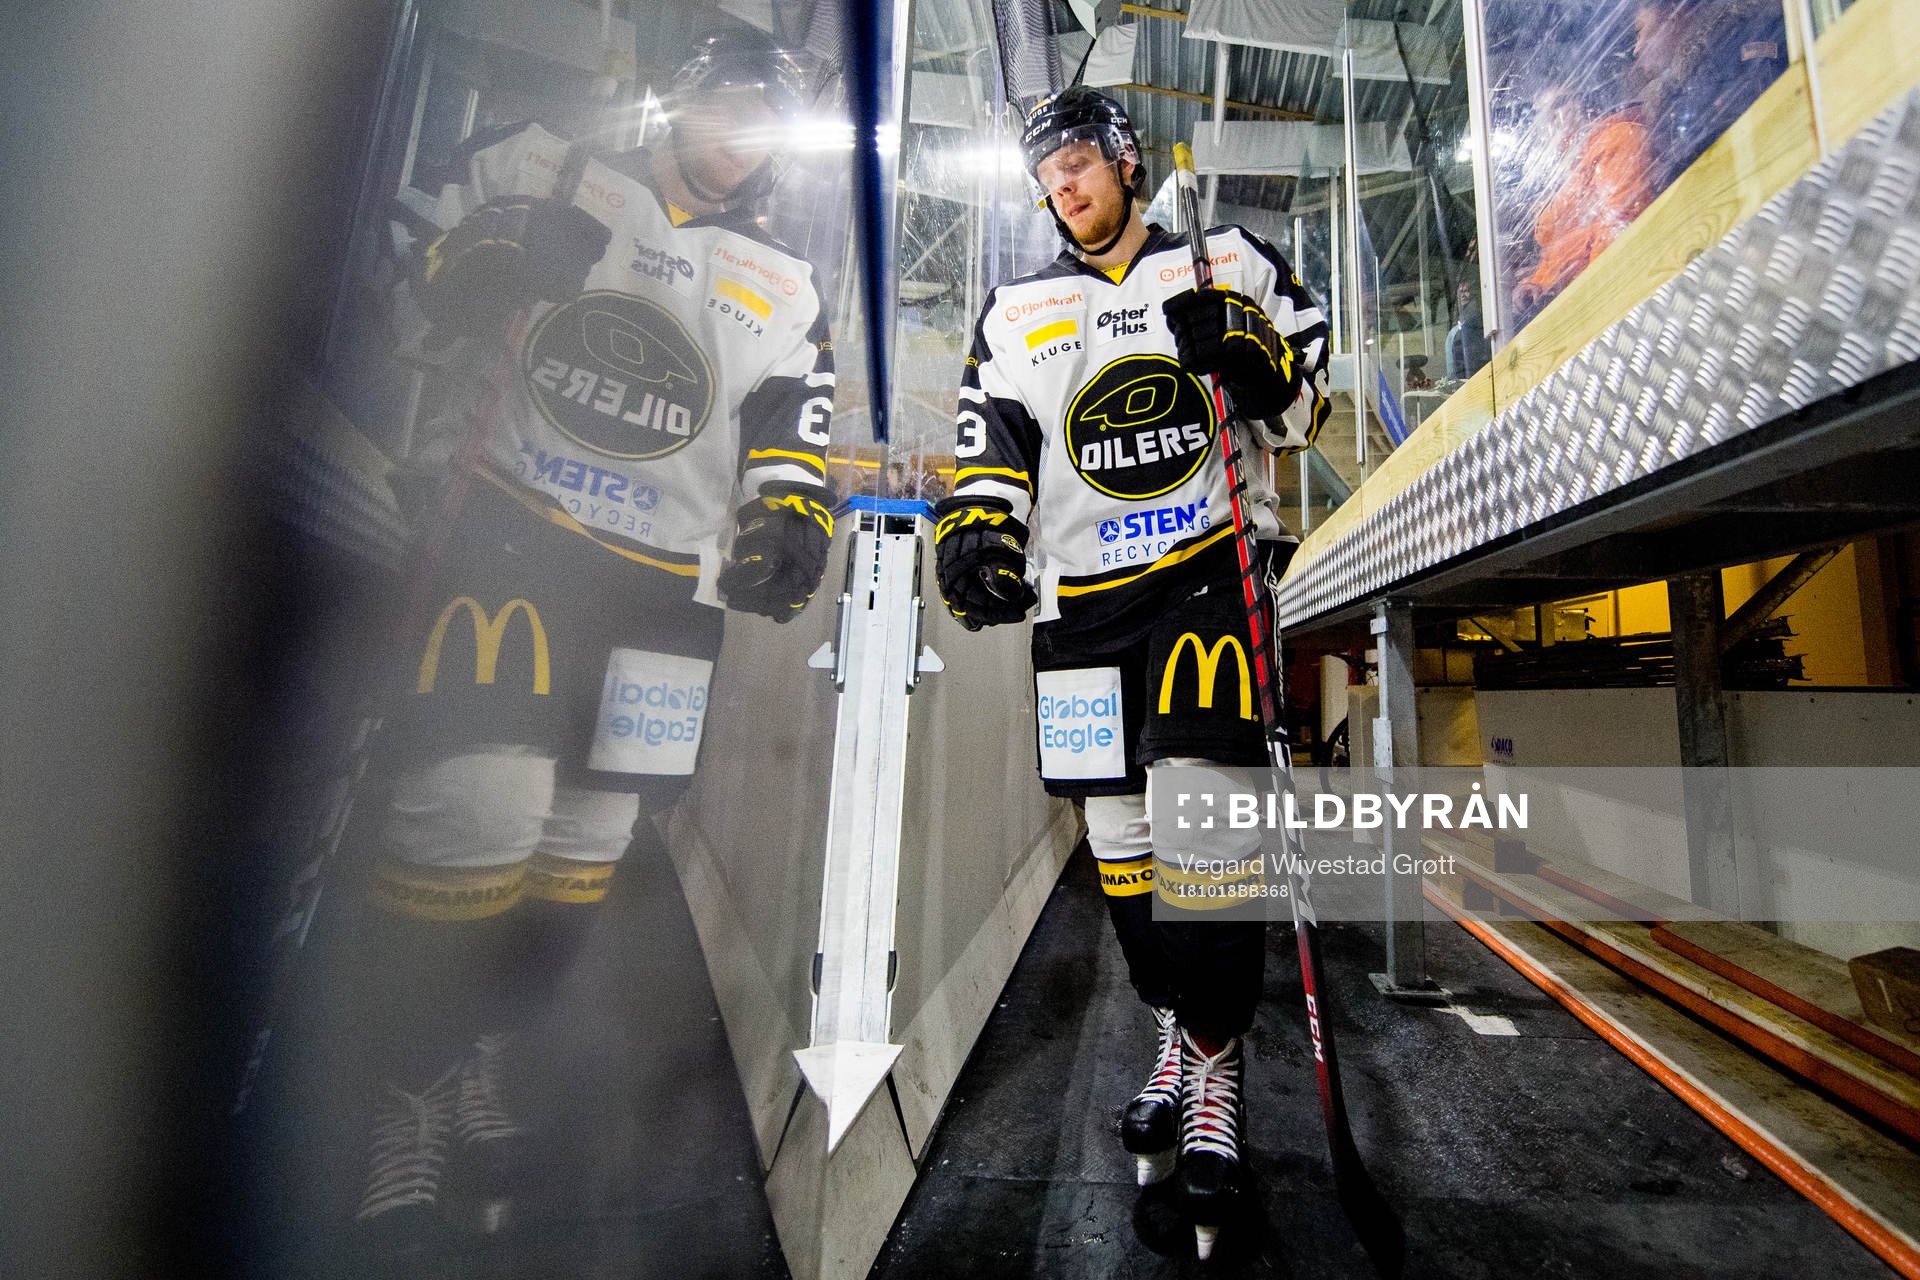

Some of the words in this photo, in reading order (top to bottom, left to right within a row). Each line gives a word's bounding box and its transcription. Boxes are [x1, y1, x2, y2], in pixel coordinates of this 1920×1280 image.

[1025, 118, 1052, 143] CCM
[1022, 293, 1083, 315] Fjordkraft
[1112, 321, 1148, 338] Hus
[1031, 341, 1082, 367] KLUGE
[1080, 423, 1209, 471] OILERS
[1040, 693, 1117, 720] Global
[1306, 993, 1324, 1063] CCM
